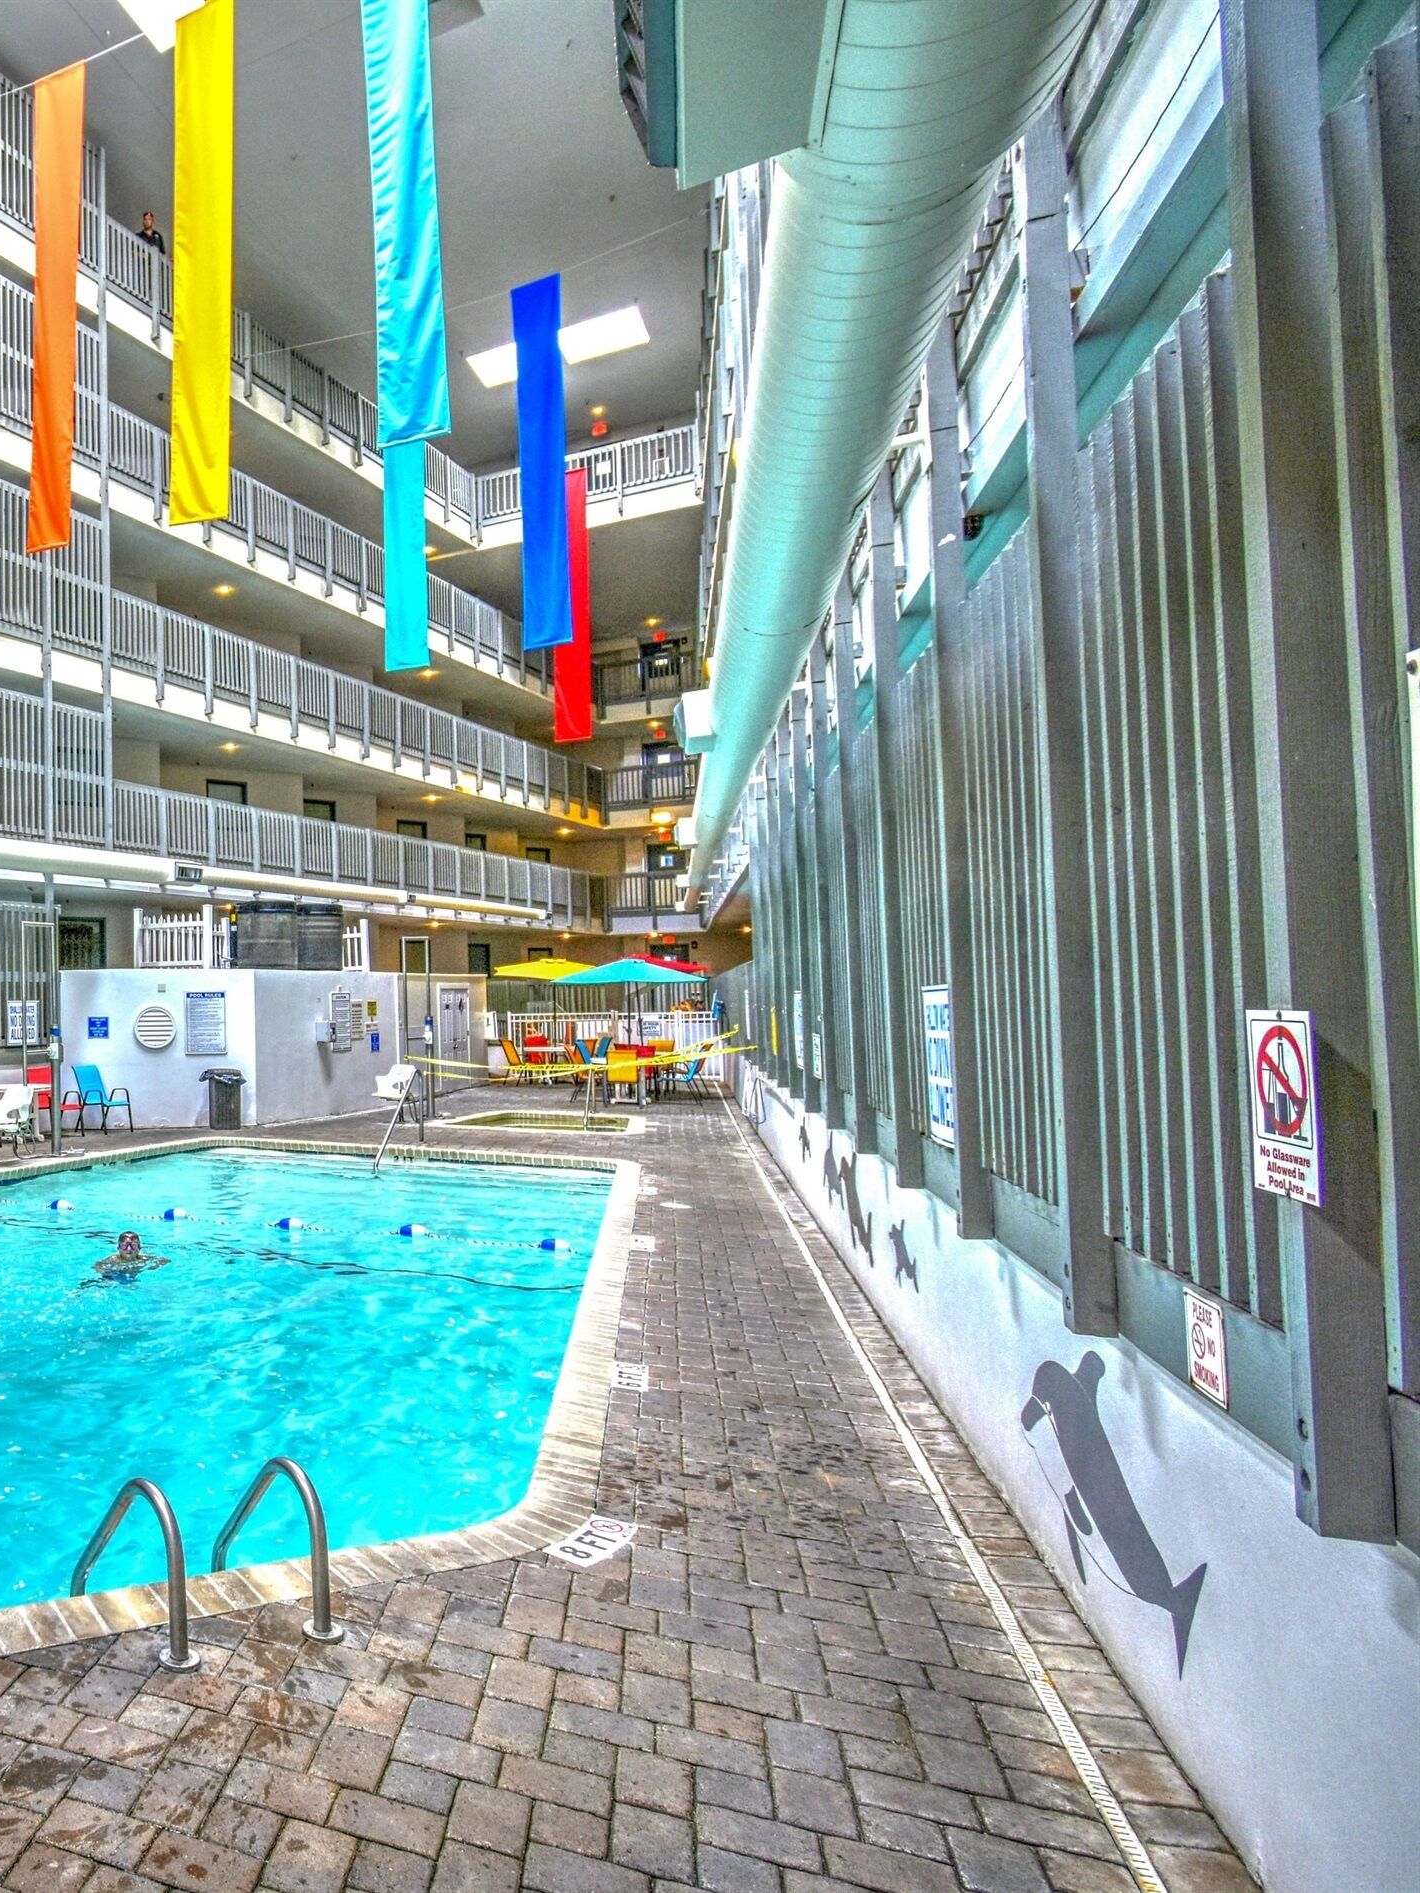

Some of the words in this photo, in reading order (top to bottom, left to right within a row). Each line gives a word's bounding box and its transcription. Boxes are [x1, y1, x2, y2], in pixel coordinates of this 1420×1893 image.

[1259, 1144, 1271, 1158] No
[1272, 1147, 1311, 1168] Glassware
[1267, 1160, 1297, 1179] Allowed
[1297, 1168, 1305, 1182] in
[1268, 1175, 1286, 1190] Pool
[1289, 1180, 1304, 1196] Area
[1192, 1302, 1213, 1329] PLEASE
[1207, 1337, 1216, 1358] NO
[618, 1370, 643, 1381] FT
[1194, 1361, 1220, 1392] SMOKING
[574, 1529, 617, 1551] FT
[559, 1545, 593, 1559] 8
